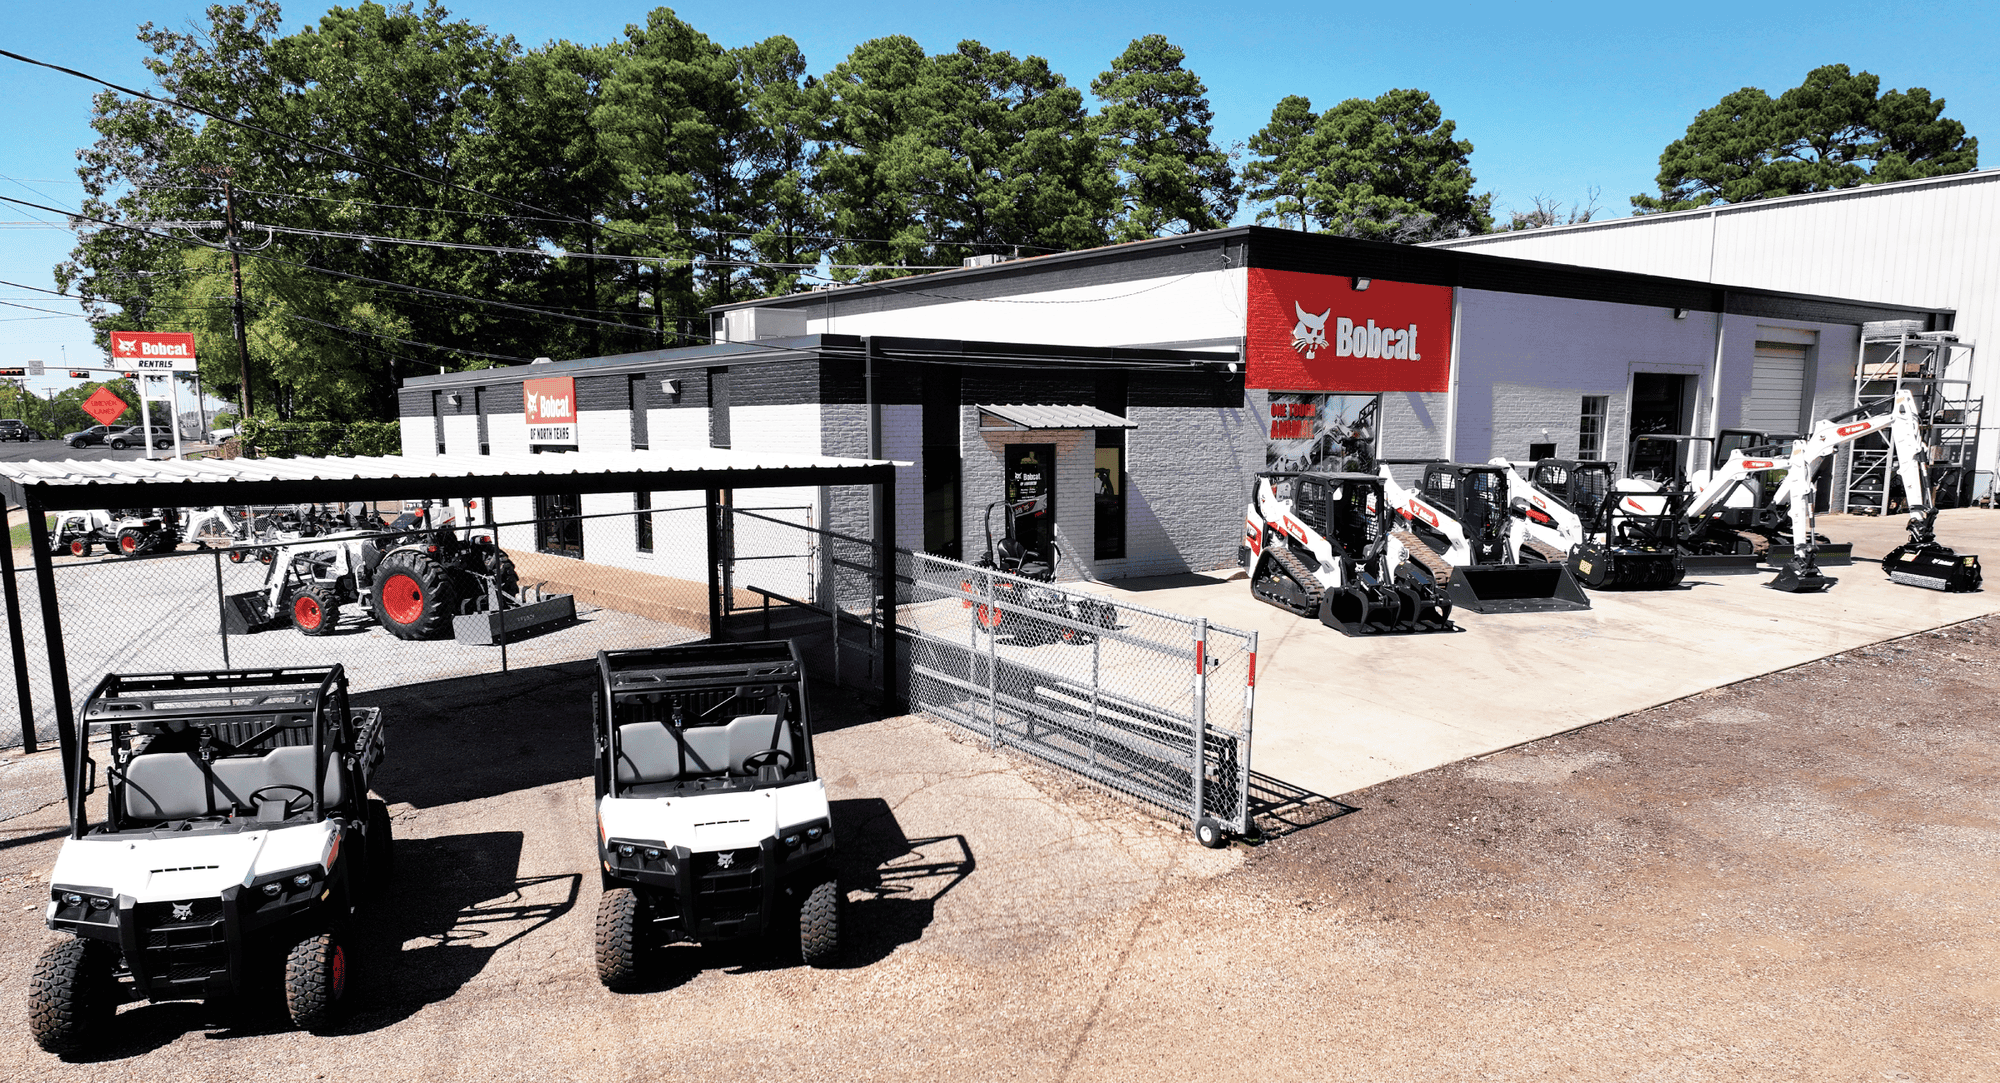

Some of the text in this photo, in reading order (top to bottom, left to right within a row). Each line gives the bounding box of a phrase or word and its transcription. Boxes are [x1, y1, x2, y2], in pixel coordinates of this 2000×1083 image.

[1336, 317, 1418, 361] Bobcat
[142, 342, 188, 356] Bobcat
[138, 360, 173, 368] RENTALS
[540, 394, 569, 418] Bobcat
[1271, 403, 1287, 417] ONE
[530, 427, 570, 440] OF NORTH TEXAS
